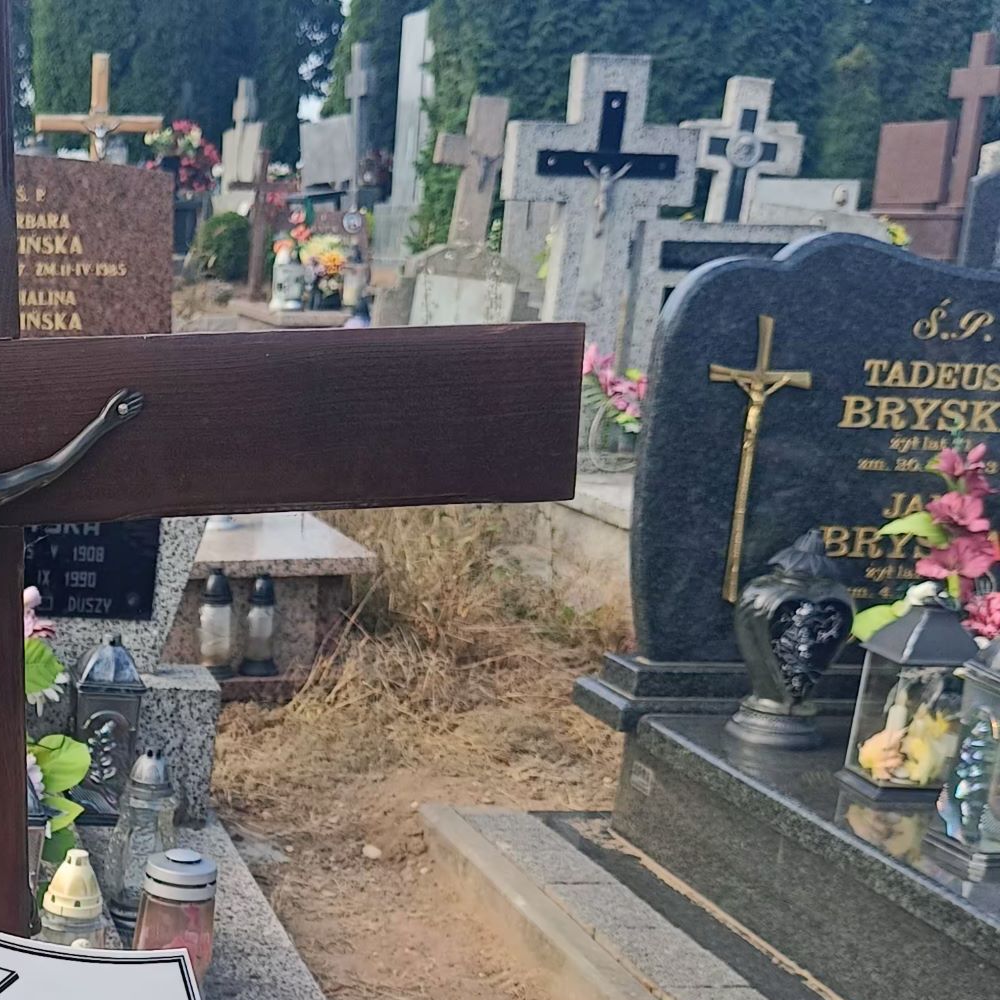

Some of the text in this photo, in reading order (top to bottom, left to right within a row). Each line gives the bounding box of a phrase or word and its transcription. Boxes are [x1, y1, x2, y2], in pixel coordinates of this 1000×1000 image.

[864, 359, 1000, 391] TADEUS
[882, 492, 940, 518] JA
[72, 546, 105, 562] 1908
[64, 571, 97, 588] 1990
[67, 596, 112, 613] DUSZY
